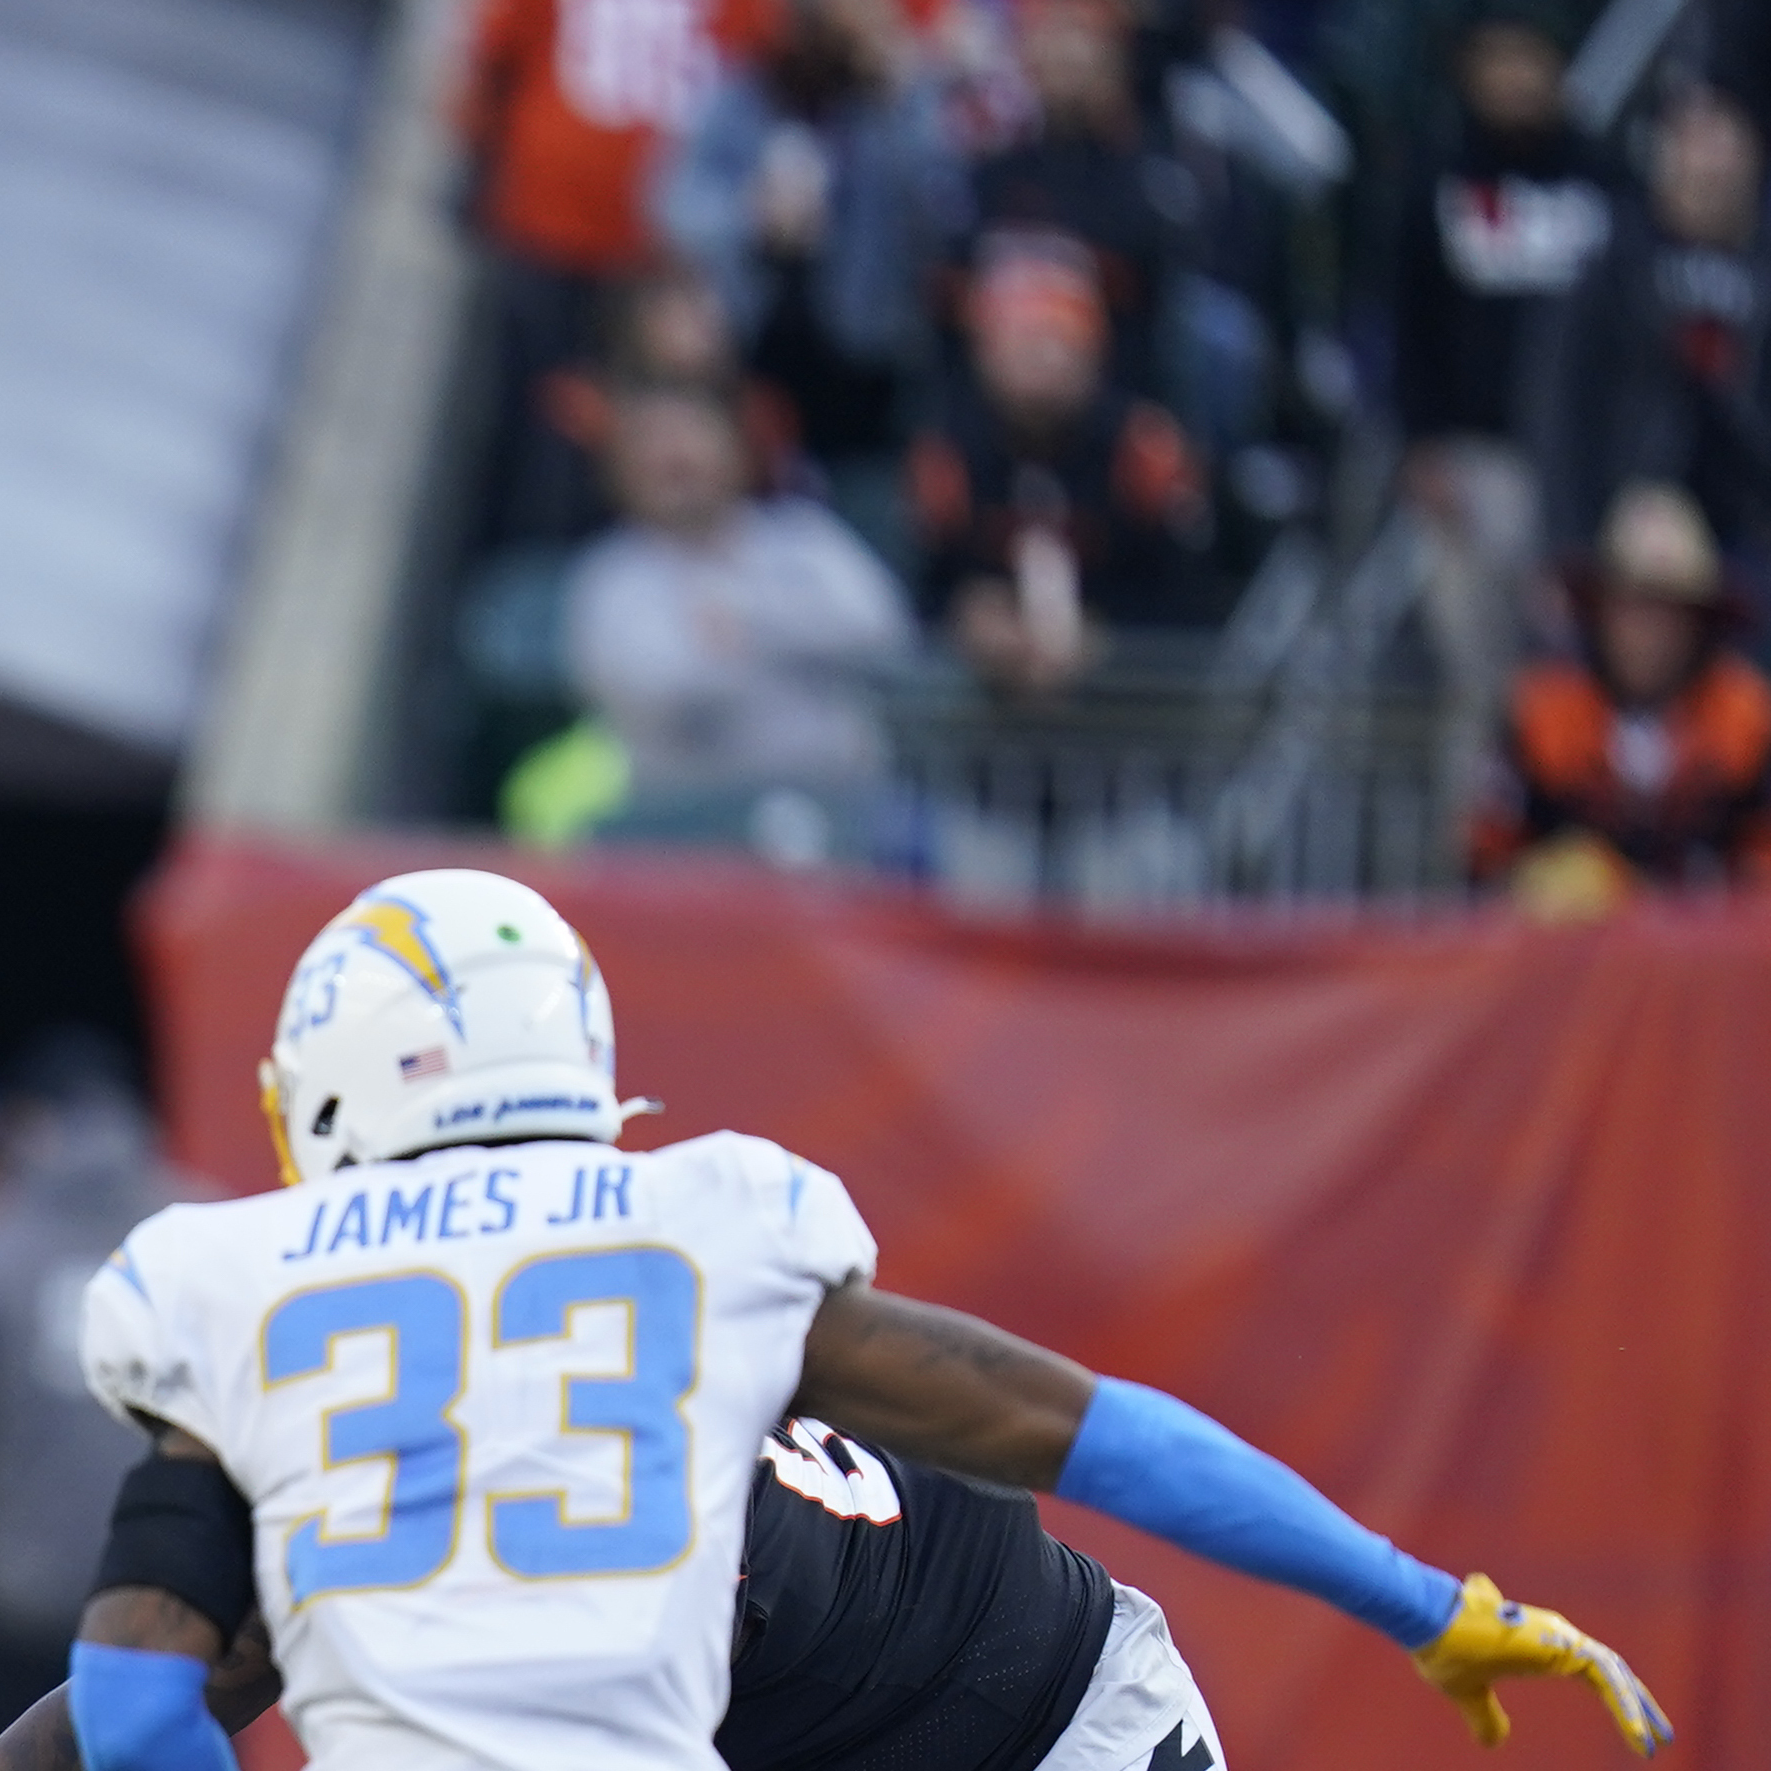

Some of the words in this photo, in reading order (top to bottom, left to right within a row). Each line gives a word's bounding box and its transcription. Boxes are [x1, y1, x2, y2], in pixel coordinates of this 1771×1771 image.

[281, 1167, 521, 1262] JAMES
[546, 1165, 632, 1226] JR
[259, 1242, 705, 1612] 33
